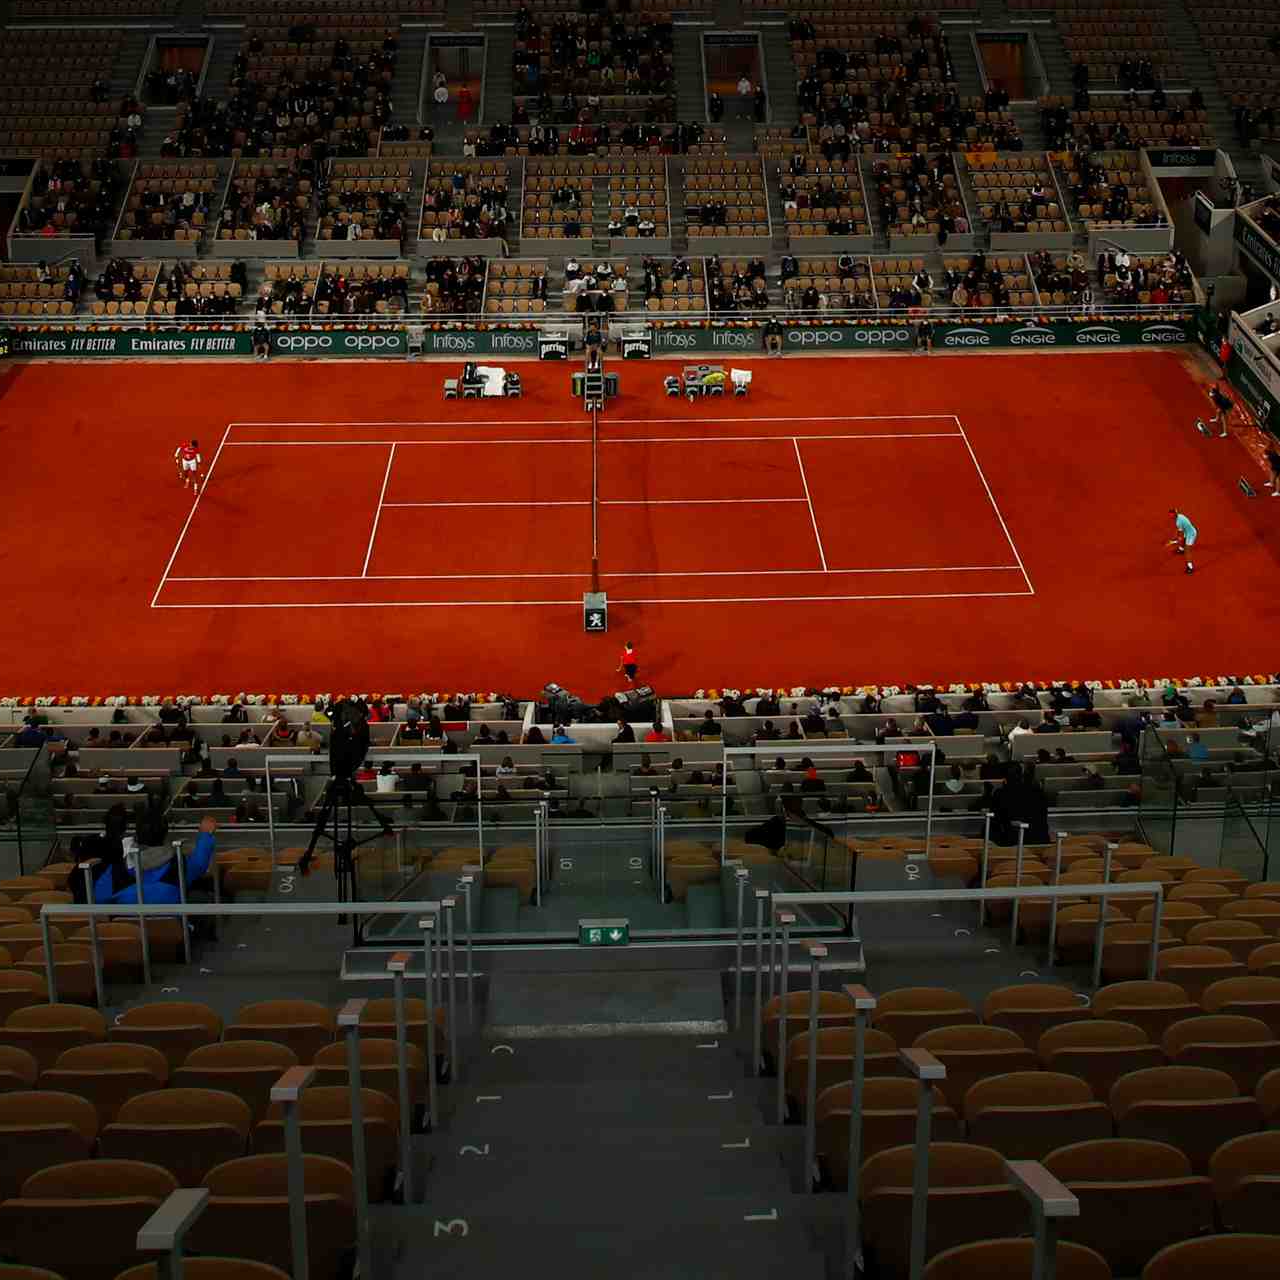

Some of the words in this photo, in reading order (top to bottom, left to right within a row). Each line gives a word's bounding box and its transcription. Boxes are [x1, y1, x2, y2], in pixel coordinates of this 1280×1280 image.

[12, 336, 66, 352] Emirates
[70, 337, 85, 352] FLY
[86, 336, 116, 352] BETTER
[131, 336, 186, 352] Emirates
[190, 337, 205, 352] FLY
[206, 336, 236, 352] BETTER
[277, 335, 332, 350] oppo
[344, 335, 400, 350] oppo
[433, 333, 475, 350] Infosys
[491, 333, 534, 350] Infosys
[655, 331, 697, 347] Infosys
[712, 330, 754, 347] Infosys
[788, 330, 843, 345] oppo
[855, 329, 910, 344] oppo
